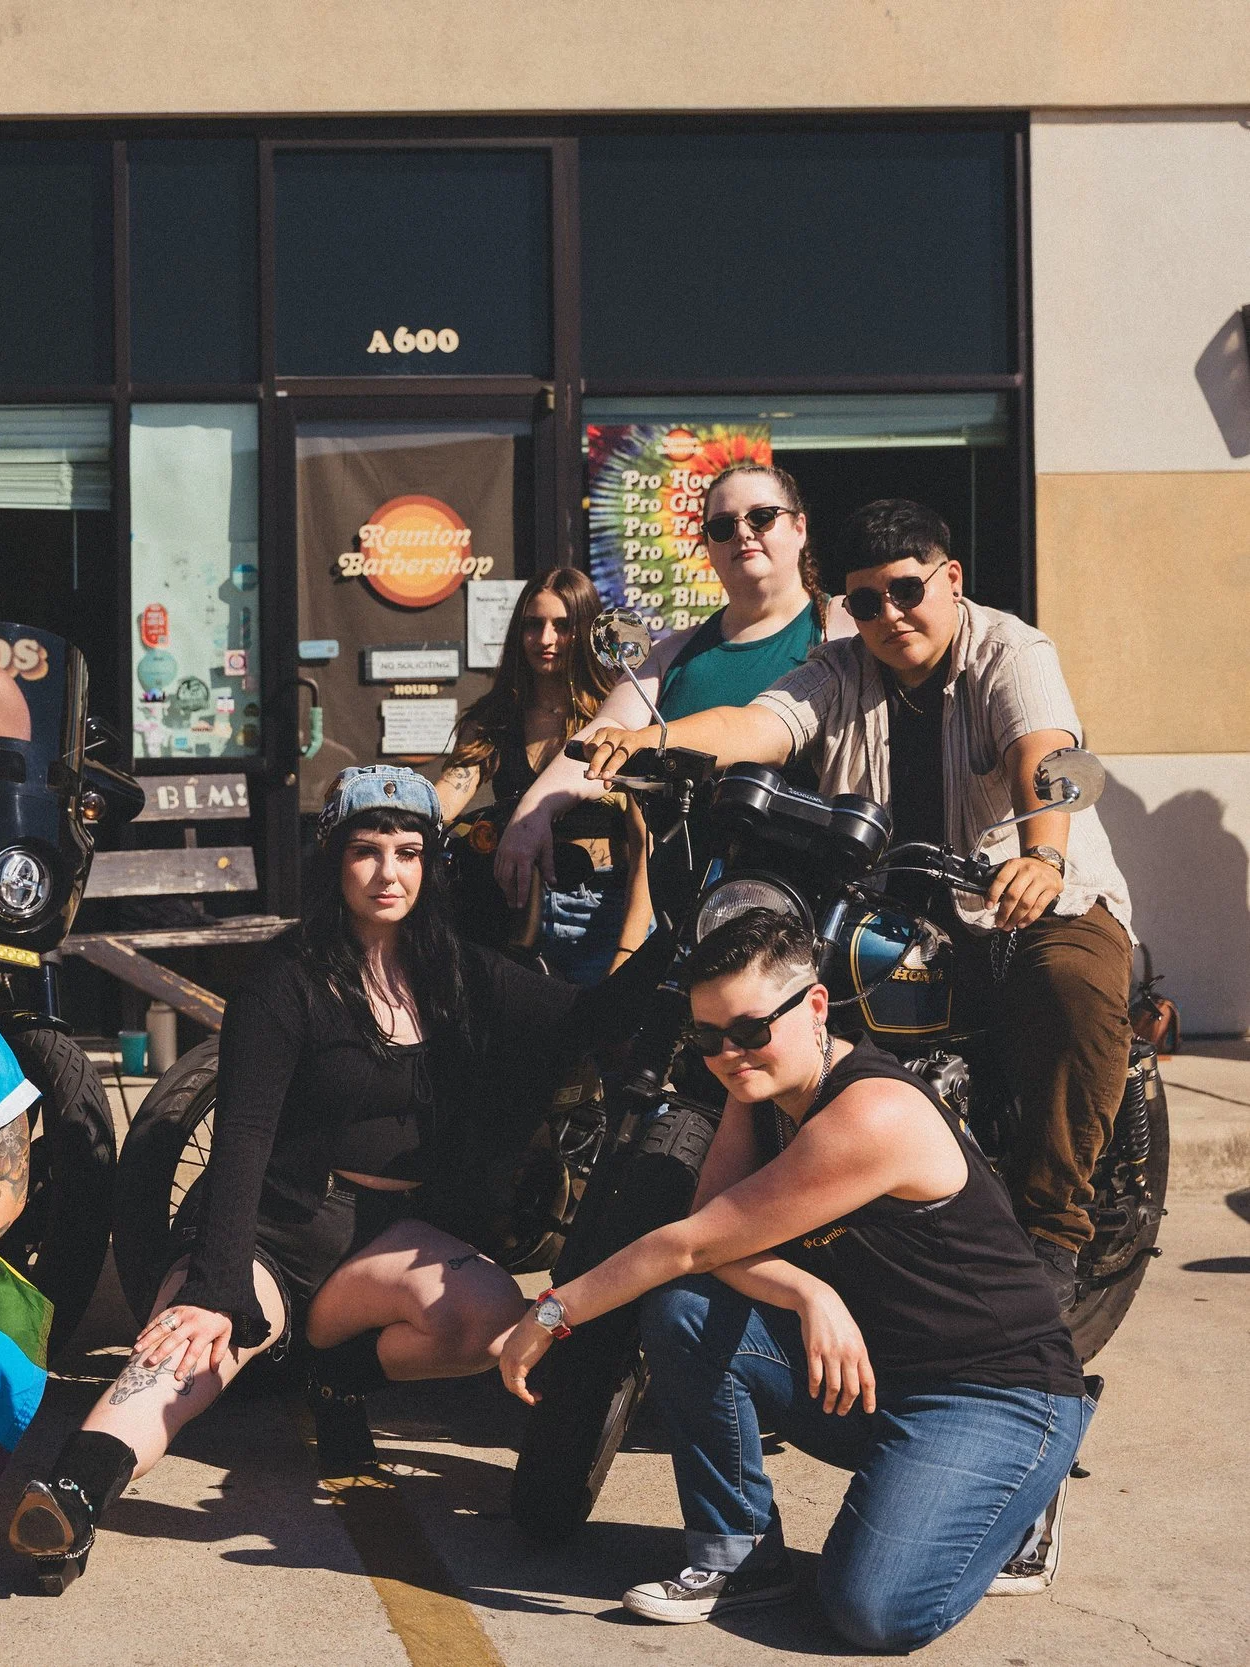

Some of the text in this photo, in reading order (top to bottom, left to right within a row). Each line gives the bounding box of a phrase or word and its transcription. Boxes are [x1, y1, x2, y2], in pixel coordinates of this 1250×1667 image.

[366, 326, 459, 354] A600
[622, 470, 662, 490] Pro
[622, 493, 663, 513] Pro
[623, 517, 663, 537] Pro
[359, 524, 472, 554] Reunion
[623, 539, 710, 560] Pro We
[338, 551, 494, 580] Barbershop
[623, 564, 664, 584] Pro
[624, 587, 664, 608] Pro
[395, 684, 438, 696] HOURS
[157, 783, 248, 810] BLM!
